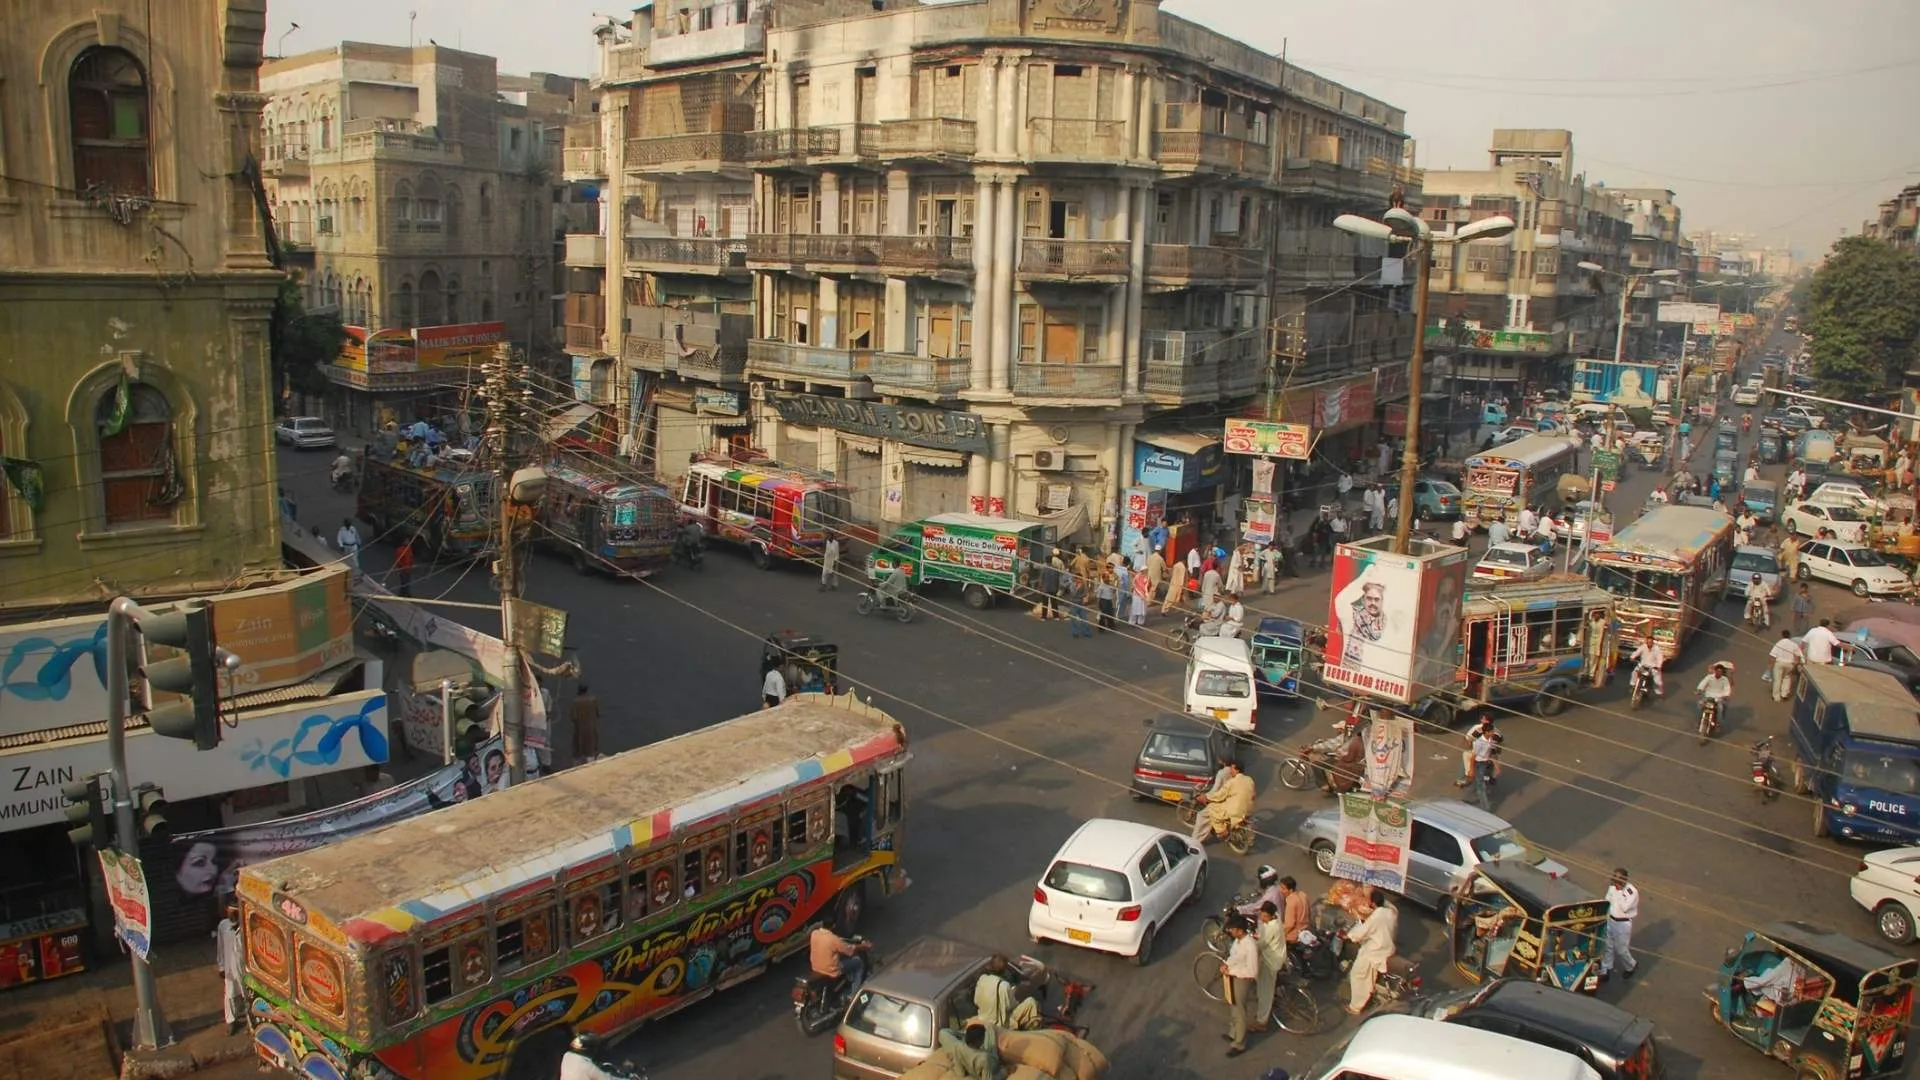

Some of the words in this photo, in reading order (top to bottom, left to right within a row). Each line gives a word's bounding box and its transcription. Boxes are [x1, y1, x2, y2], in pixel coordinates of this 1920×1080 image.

[452, 334, 473, 346] TENT
[897, 410, 946, 433] SONS
[957, 538, 980, 548] Office
[1375, 679, 1404, 696] SECTOR
[12, 766, 74, 792] ZAIN
[1869, 799, 1906, 815] POLICE
